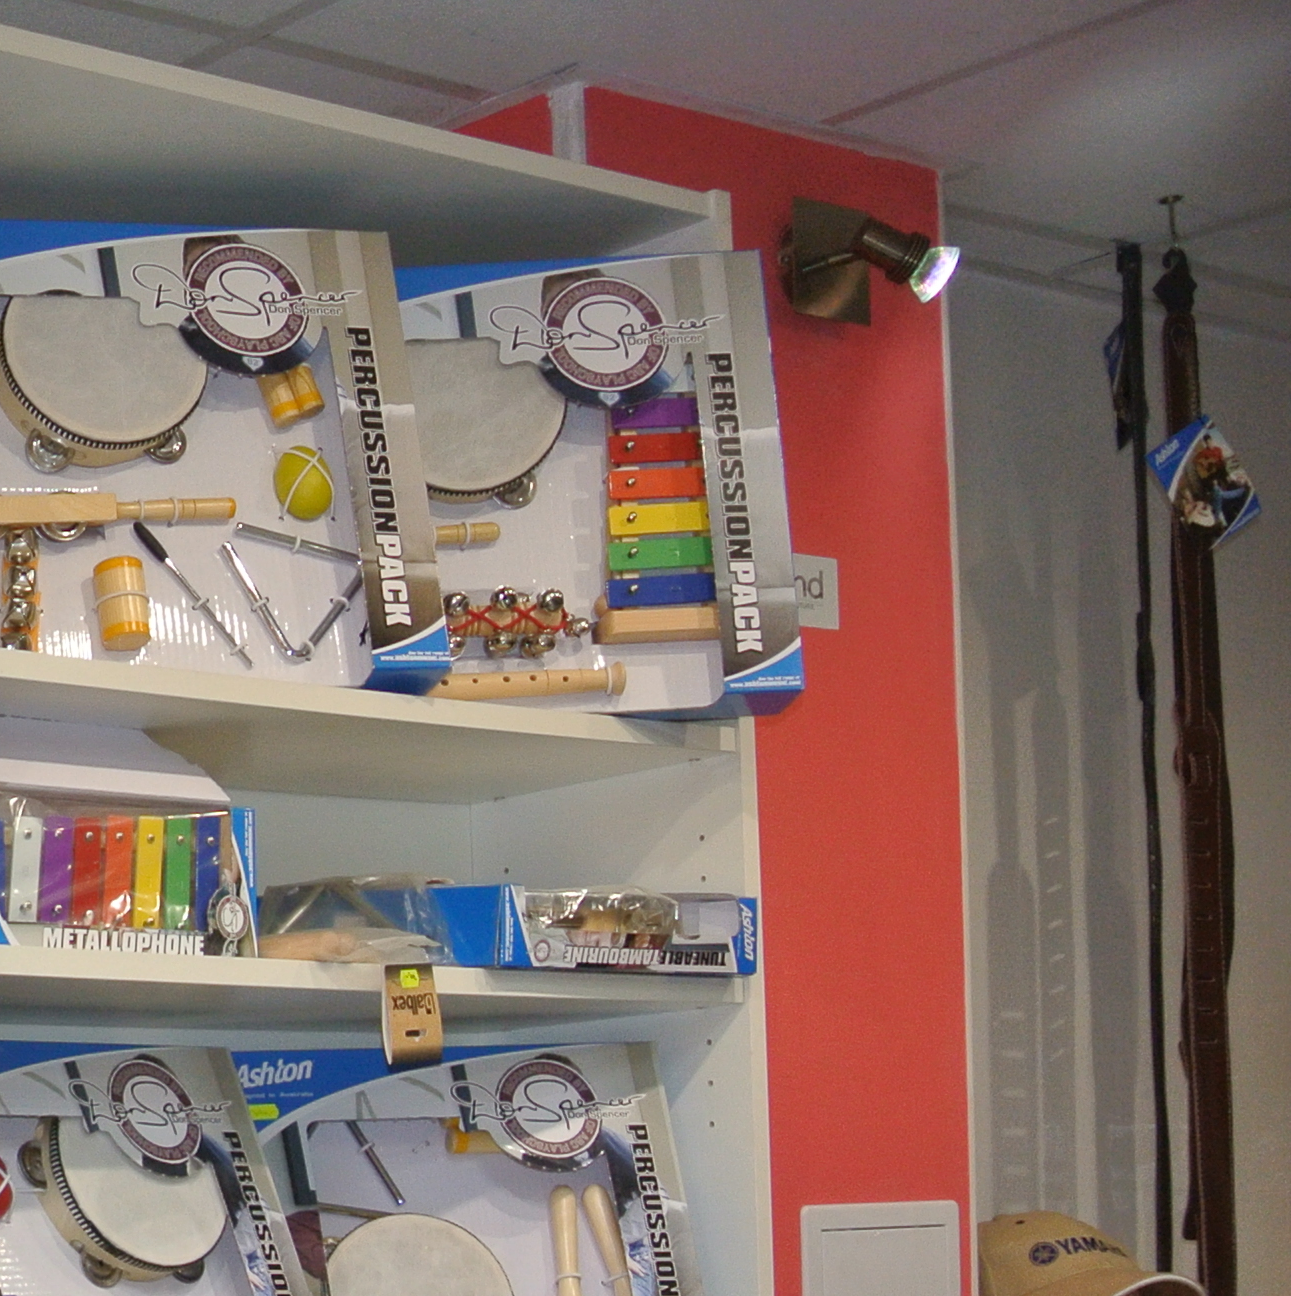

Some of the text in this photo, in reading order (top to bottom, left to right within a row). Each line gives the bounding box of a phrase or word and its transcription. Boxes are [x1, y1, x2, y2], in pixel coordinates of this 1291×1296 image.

[268, 304, 343, 317] Don Spencer
[627, 334, 704, 346] Don Spencer
[41, 927, 206, 957] METALLOPHONE
[739, 902, 758, 962] Ashton
[237, 1059, 314, 1089] Ashton
